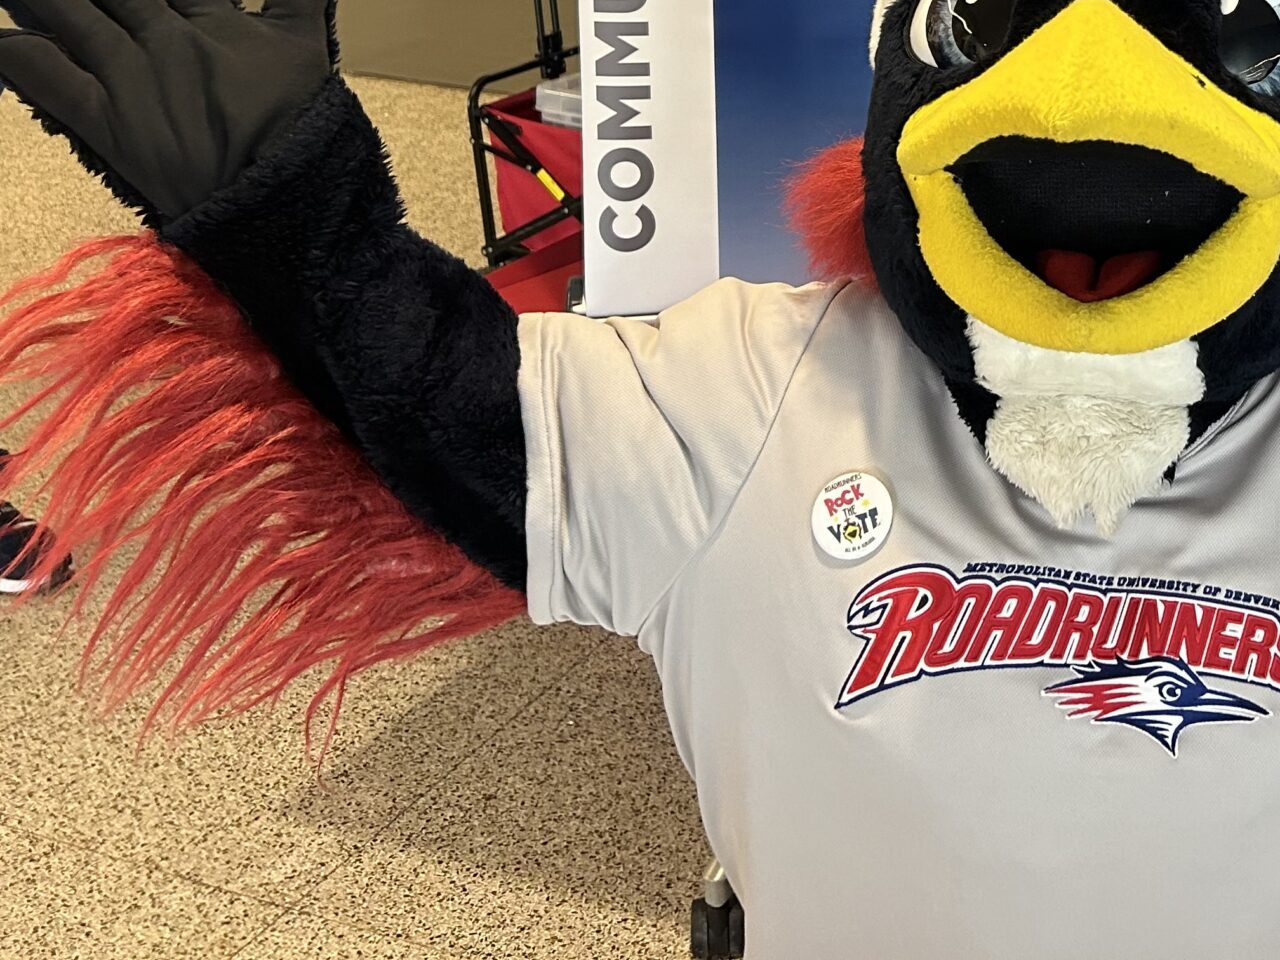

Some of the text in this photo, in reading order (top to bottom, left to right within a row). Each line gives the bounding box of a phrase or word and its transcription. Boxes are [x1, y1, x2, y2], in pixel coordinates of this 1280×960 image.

[842, 504, 857, 521] THE
[963, 562, 1280, 609] METROPOLITAN STATE UNIVERSITY OF DENVER
